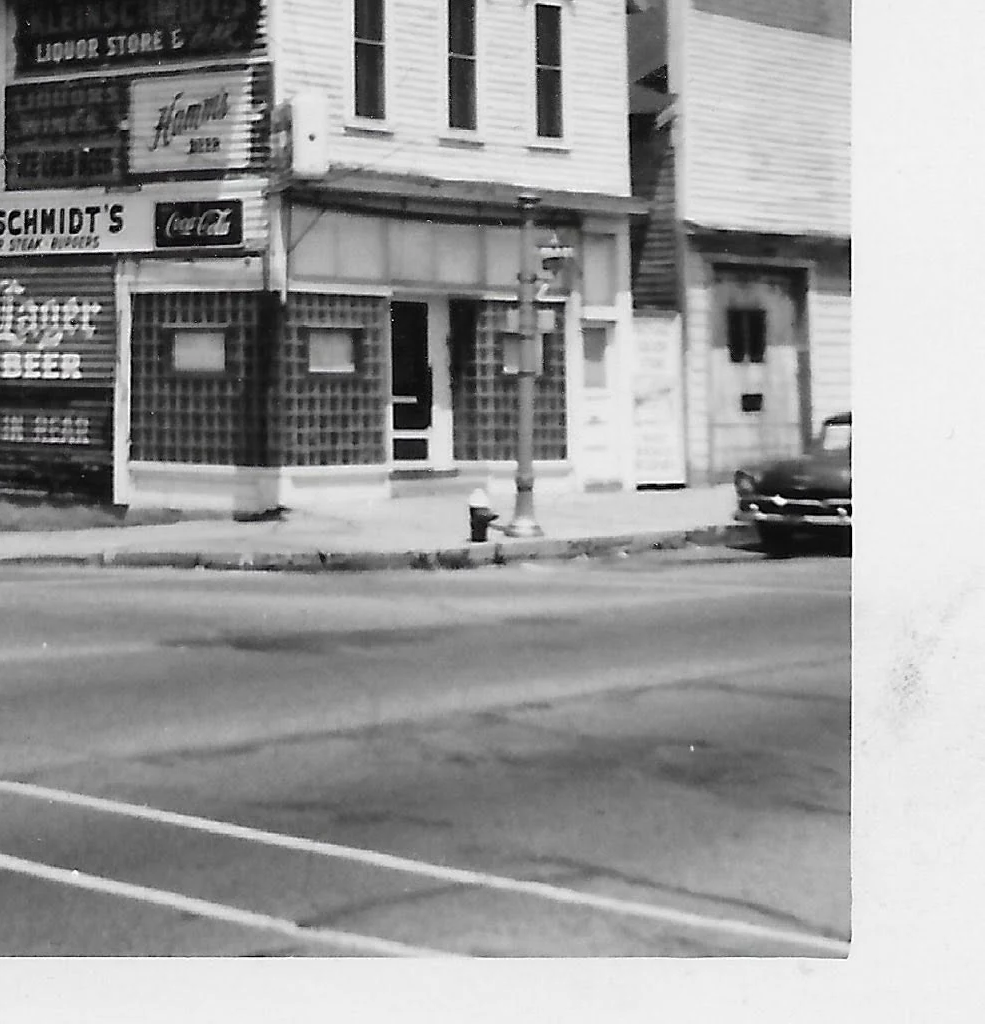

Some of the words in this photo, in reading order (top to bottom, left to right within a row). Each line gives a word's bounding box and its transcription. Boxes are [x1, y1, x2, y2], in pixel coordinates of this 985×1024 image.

[36, 38, 100, 64] LIQUOR
[106, 31, 164, 56] STORE
[188, 136, 221, 154] BEER
[9, 237, 44, 252] STEAK
[50, 235, 101, 250] BURGERS
[0, 352, 83, 379] BEER
[1, 414, 24, 441] IN
[34, 416, 91, 444] REAR
